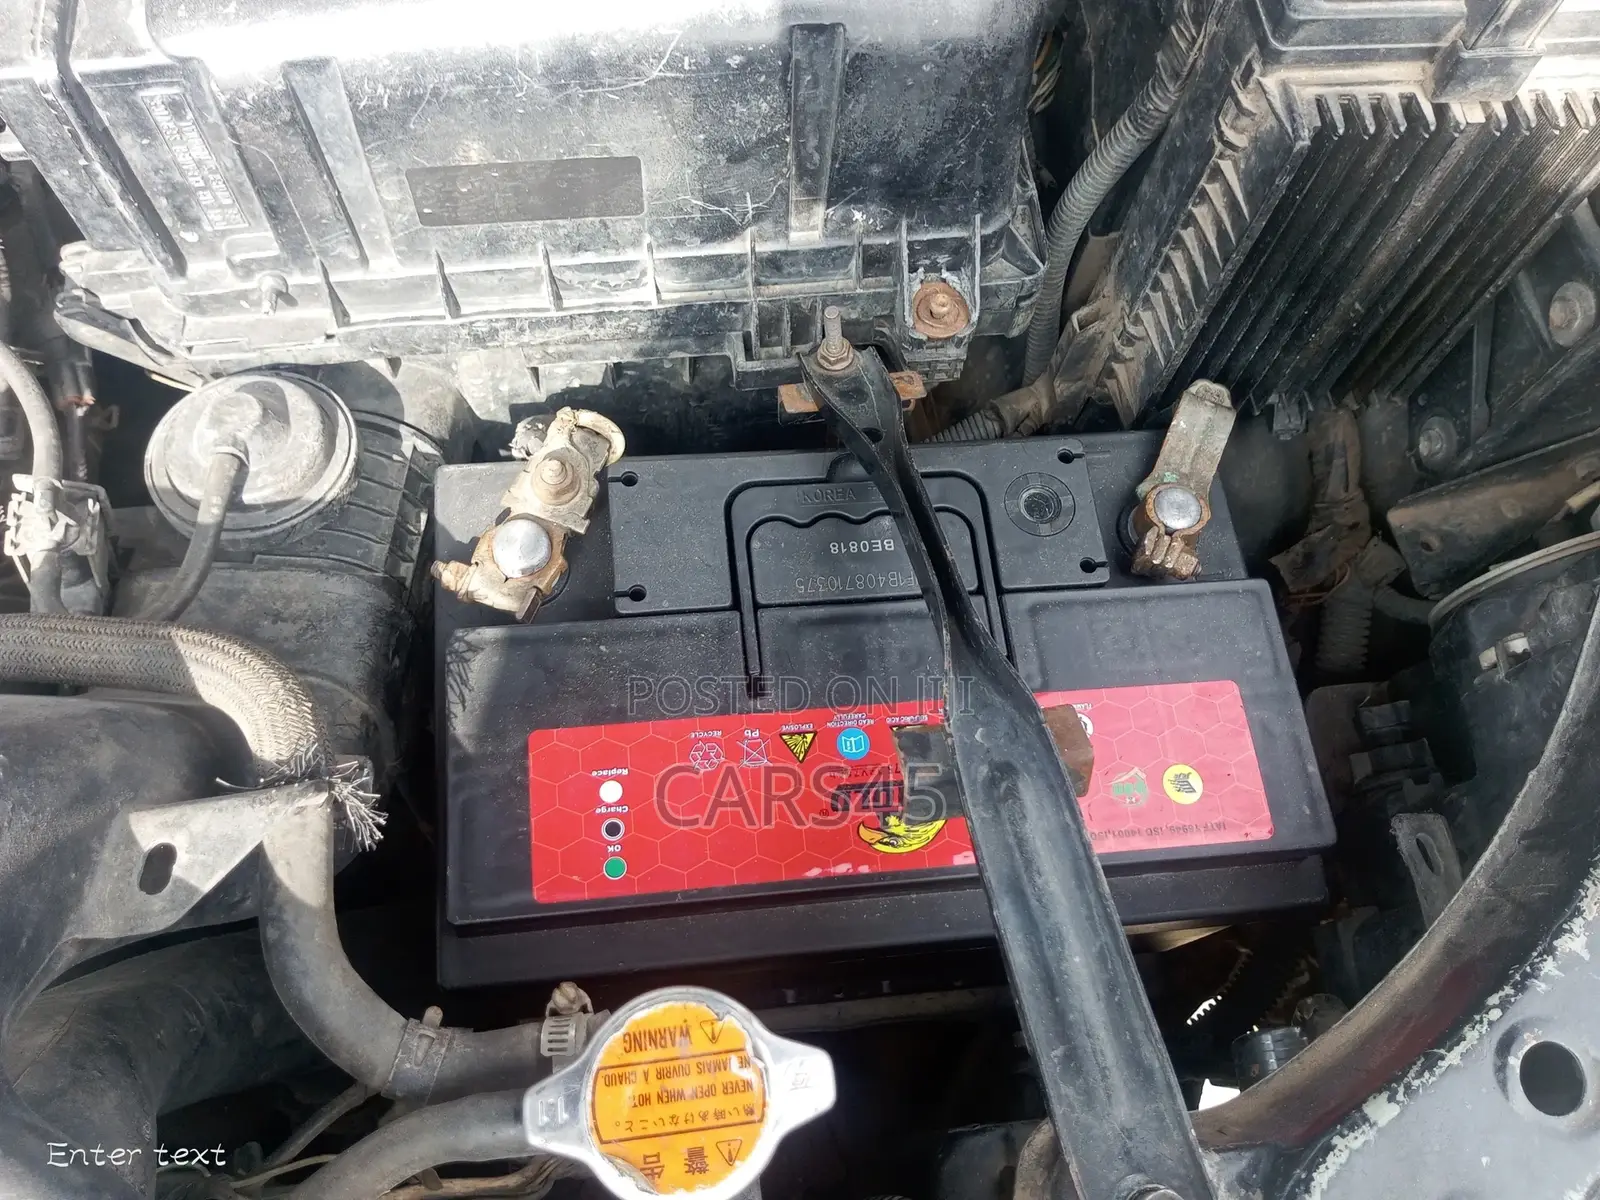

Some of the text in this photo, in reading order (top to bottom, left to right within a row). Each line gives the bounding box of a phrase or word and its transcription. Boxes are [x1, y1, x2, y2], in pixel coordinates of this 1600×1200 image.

[802, 487, 856, 503] KOREA
[829, 539, 895, 554] BE0818
[795, 571, 918, 593] F1B408710375
[826, 718, 874, 728] READ DIRECTION
[886, 716, 900, 724] ACID
[690, 730, 722, 738] RECYCLE
[744, 729, 760, 738] Pb
[592, 768, 628, 777] Replace
[595, 805, 628, 814] Charge
[606, 844, 622, 852] OK
[623, 1024, 692, 1053] WARNING
[601, 1070, 637, 1086] CHAUD.
[656, 1064, 690, 1080] OUVRIR
[690, 1083, 716, 1099] OPEN
[722, 1079, 753, 1094] NEVER
[656, 1087, 686, 1104] WHEN
